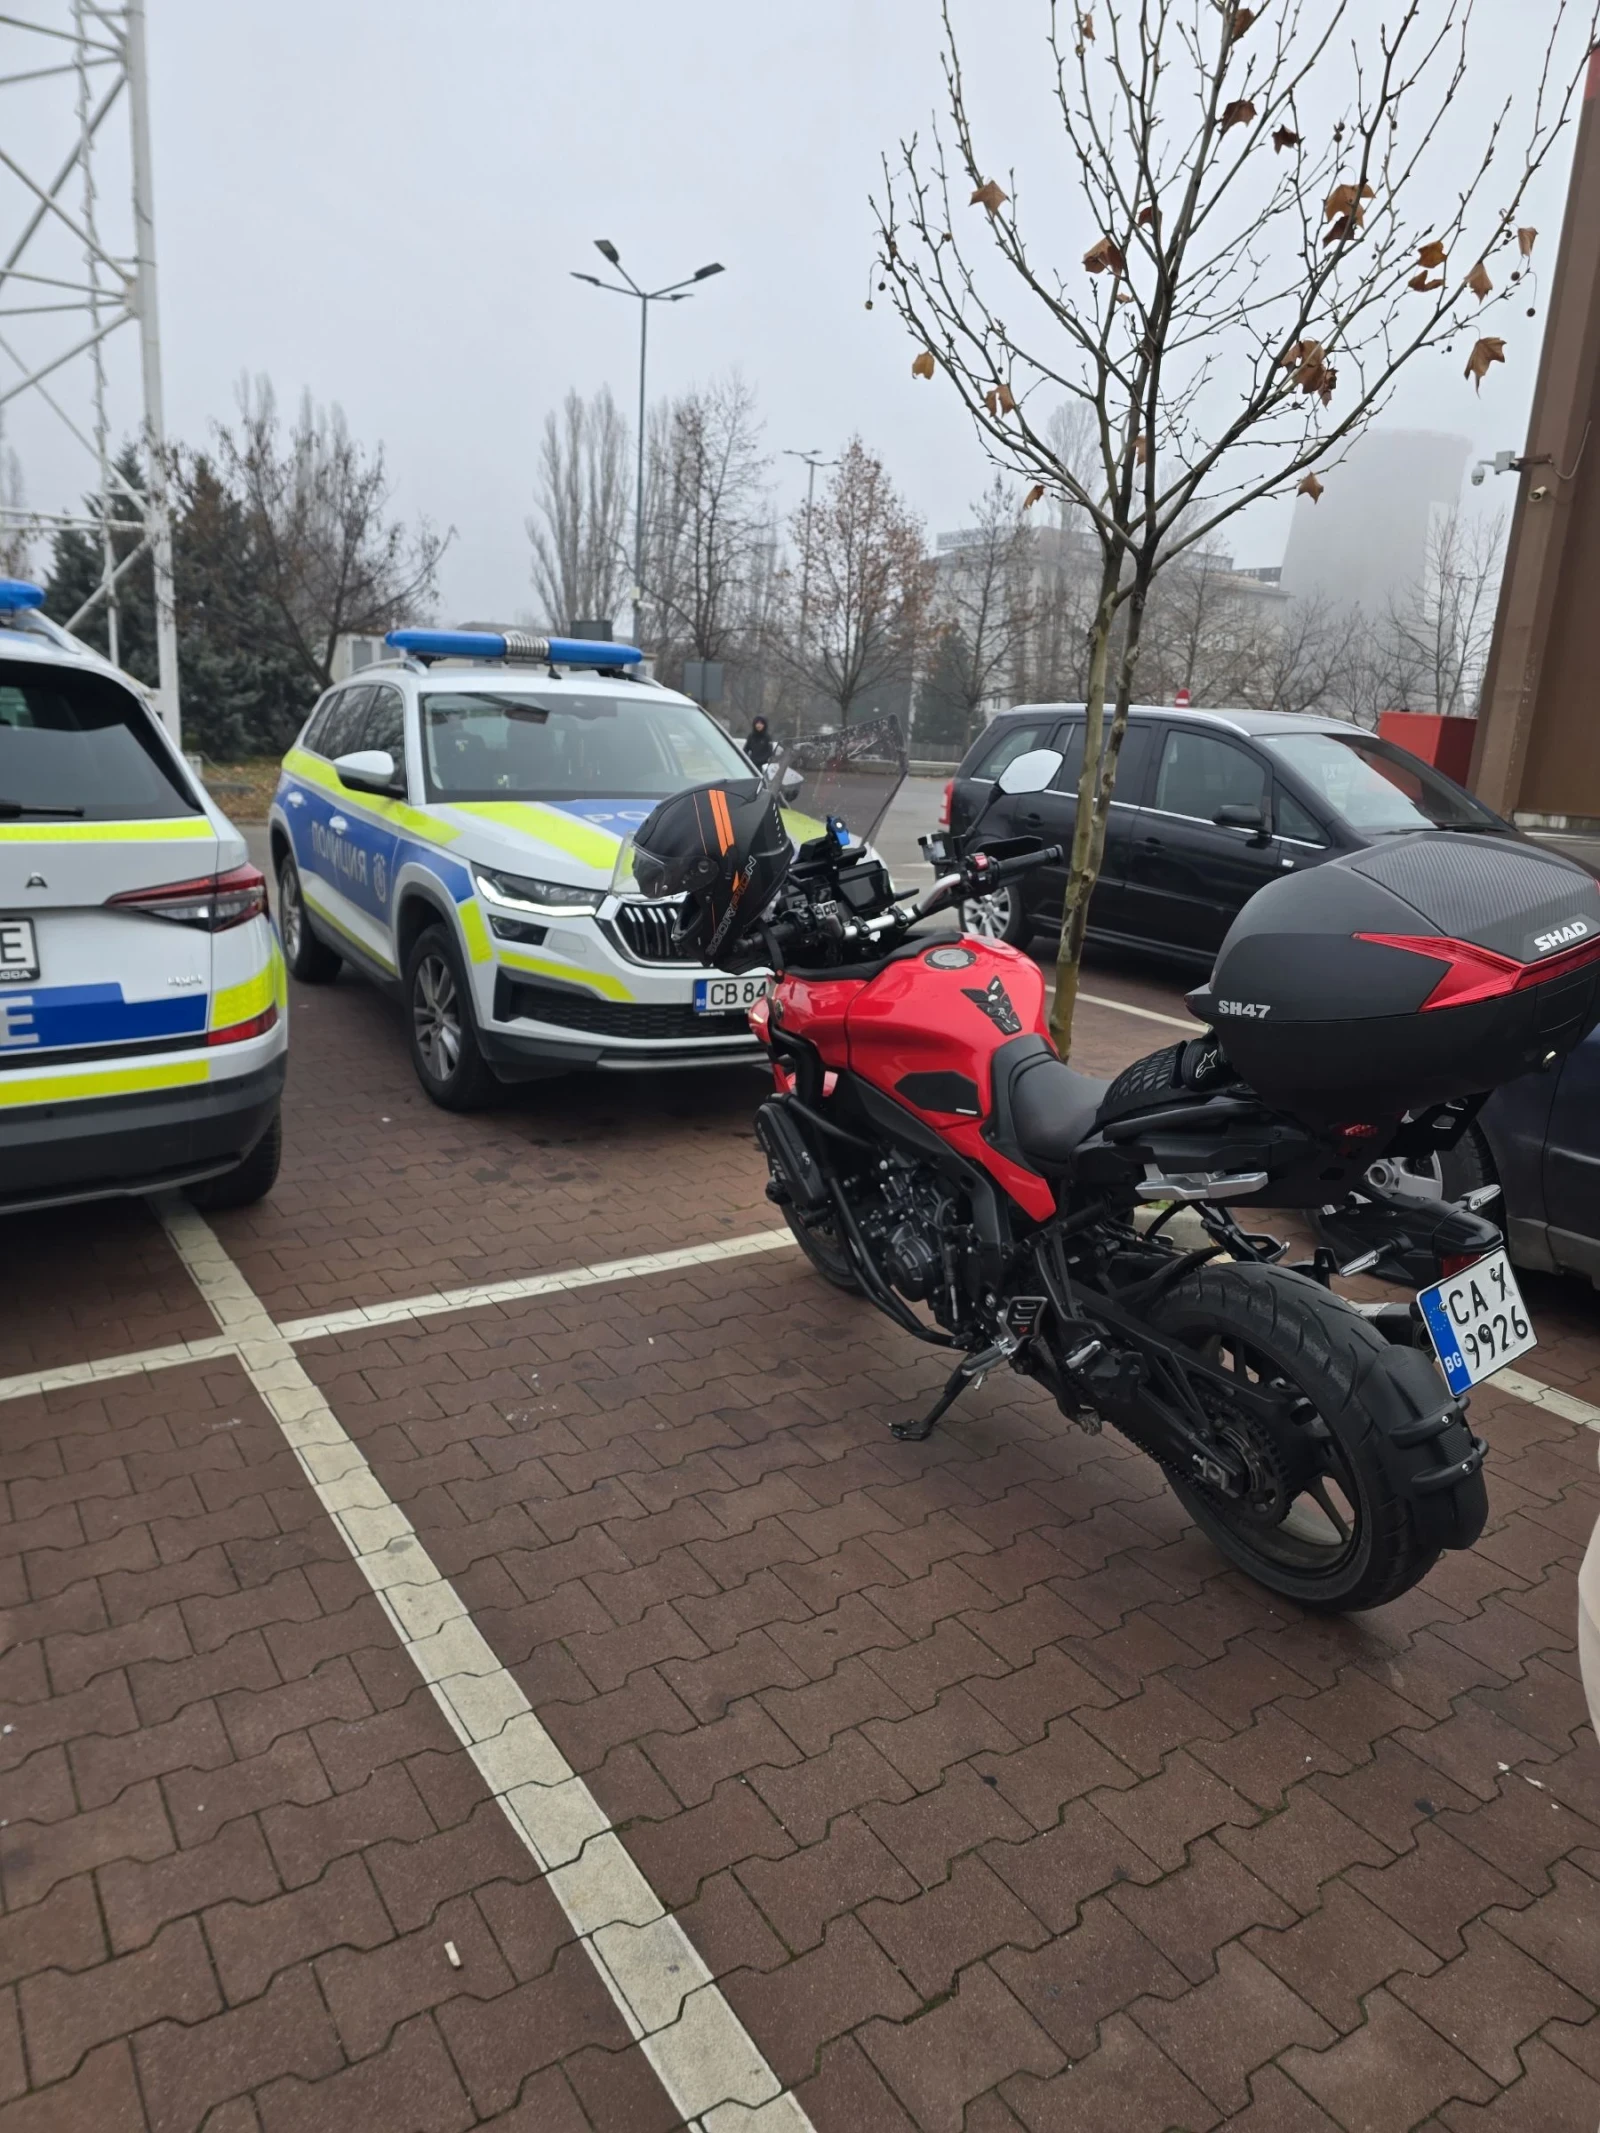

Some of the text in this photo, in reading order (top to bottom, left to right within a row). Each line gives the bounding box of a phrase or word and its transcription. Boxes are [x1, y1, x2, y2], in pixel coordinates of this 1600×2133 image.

[311, 820, 368, 886] ПОЛИЦИЯ
[0, 927, 27, 964] E
[1533, 921, 1588, 952] SHAD
[710, 982, 738, 1006] CB
[1218, 1000, 1271, 1019] SH47
[0, 995, 40, 1046] E
[1448, 1279, 1489, 1325] CA
[1443, 1305, 1529, 1374] BG 9926
